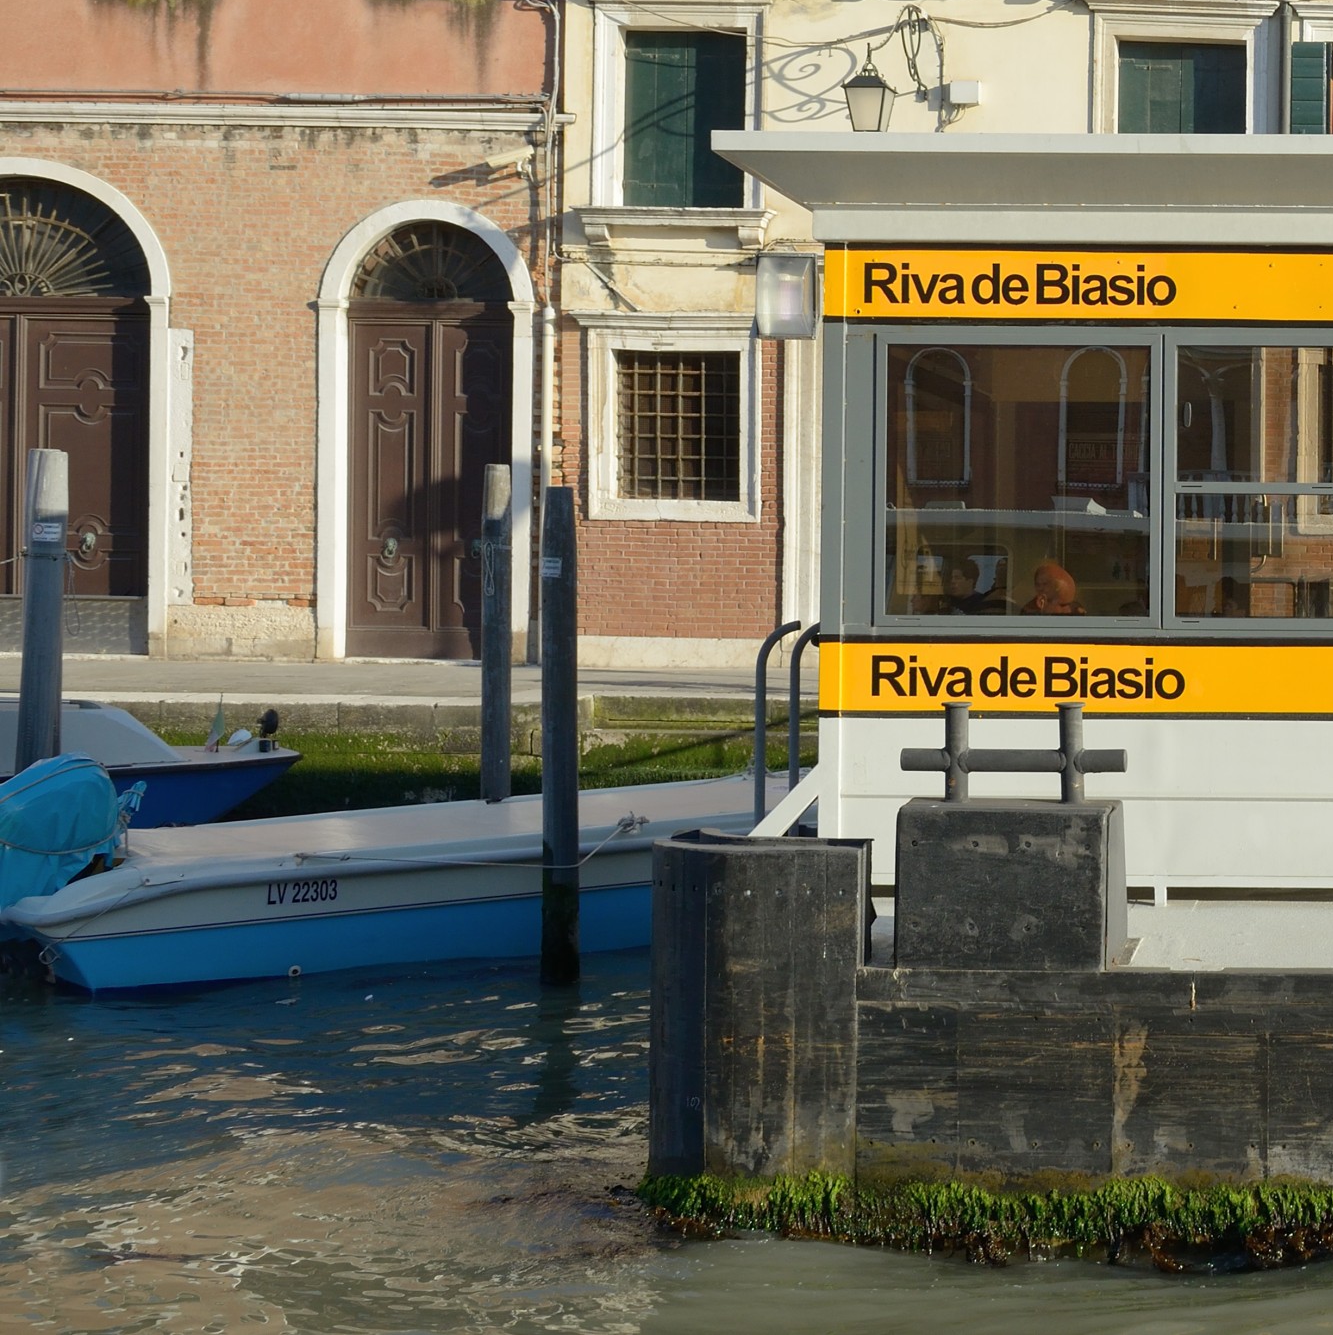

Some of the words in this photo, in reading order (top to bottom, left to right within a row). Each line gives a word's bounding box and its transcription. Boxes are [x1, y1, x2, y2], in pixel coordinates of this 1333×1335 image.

[864, 262, 965, 305] Riva
[971, 263, 1029, 306] de
[1036, 263, 1177, 306] Biasio
[871, 655, 973, 698] Riva
[979, 656, 1037, 698] de
[1044, 656, 1185, 700] Biasio
[267, 882, 288, 905] LV
[292, 879, 338, 903] 22303
